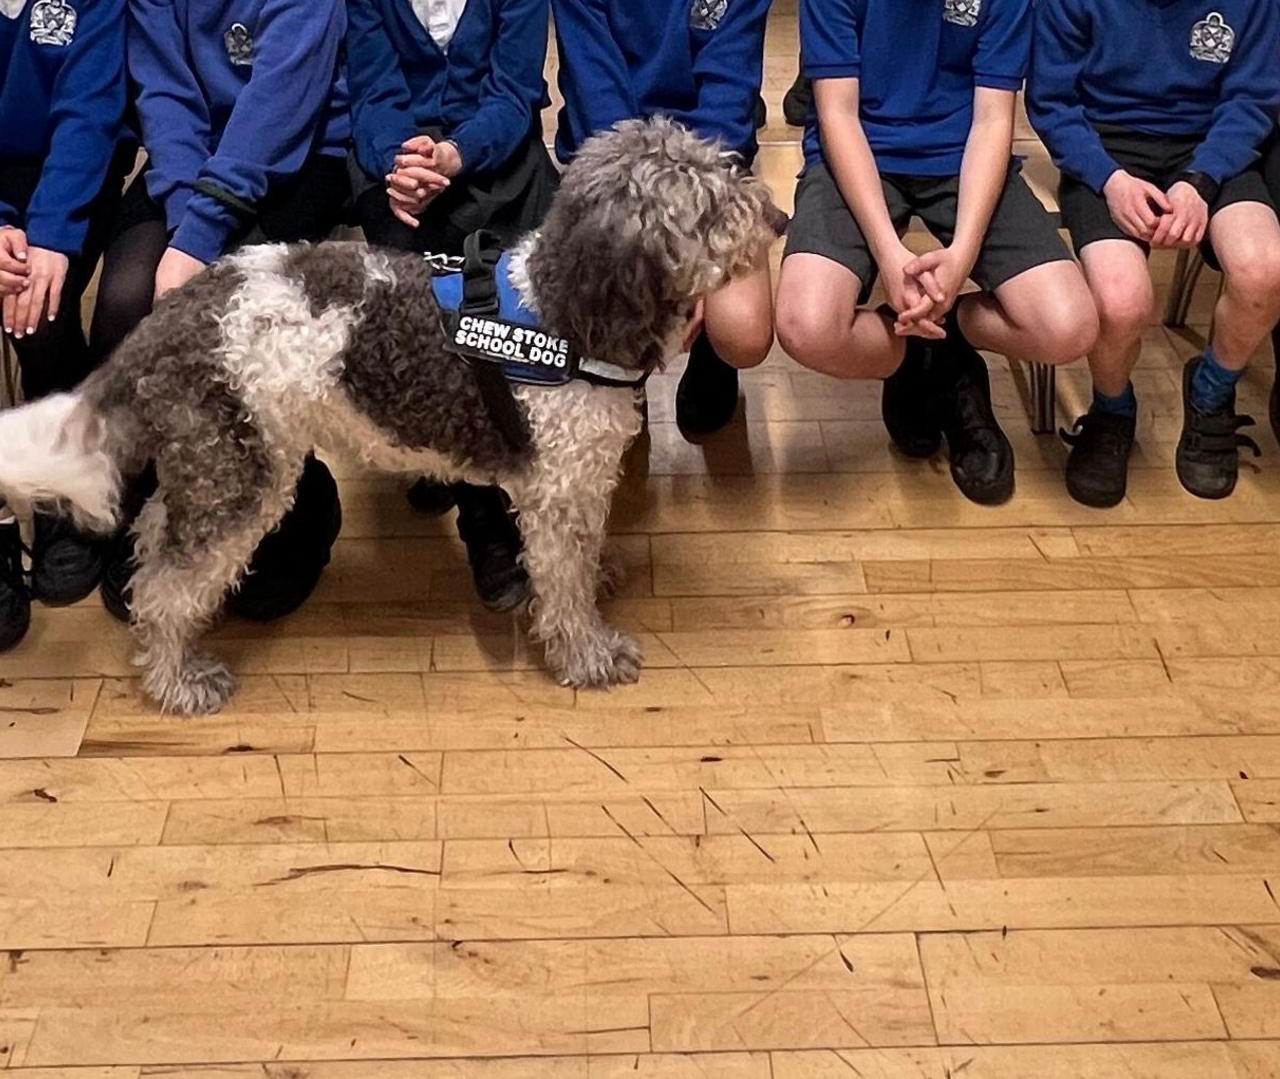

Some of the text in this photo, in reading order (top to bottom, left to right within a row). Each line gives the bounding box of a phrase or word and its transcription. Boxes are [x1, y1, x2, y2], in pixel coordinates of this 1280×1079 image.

[455, 329, 525, 358] SCHOOL
[528, 346, 567, 368] DOG
[460, 316, 569, 354] CHEW STOKE
